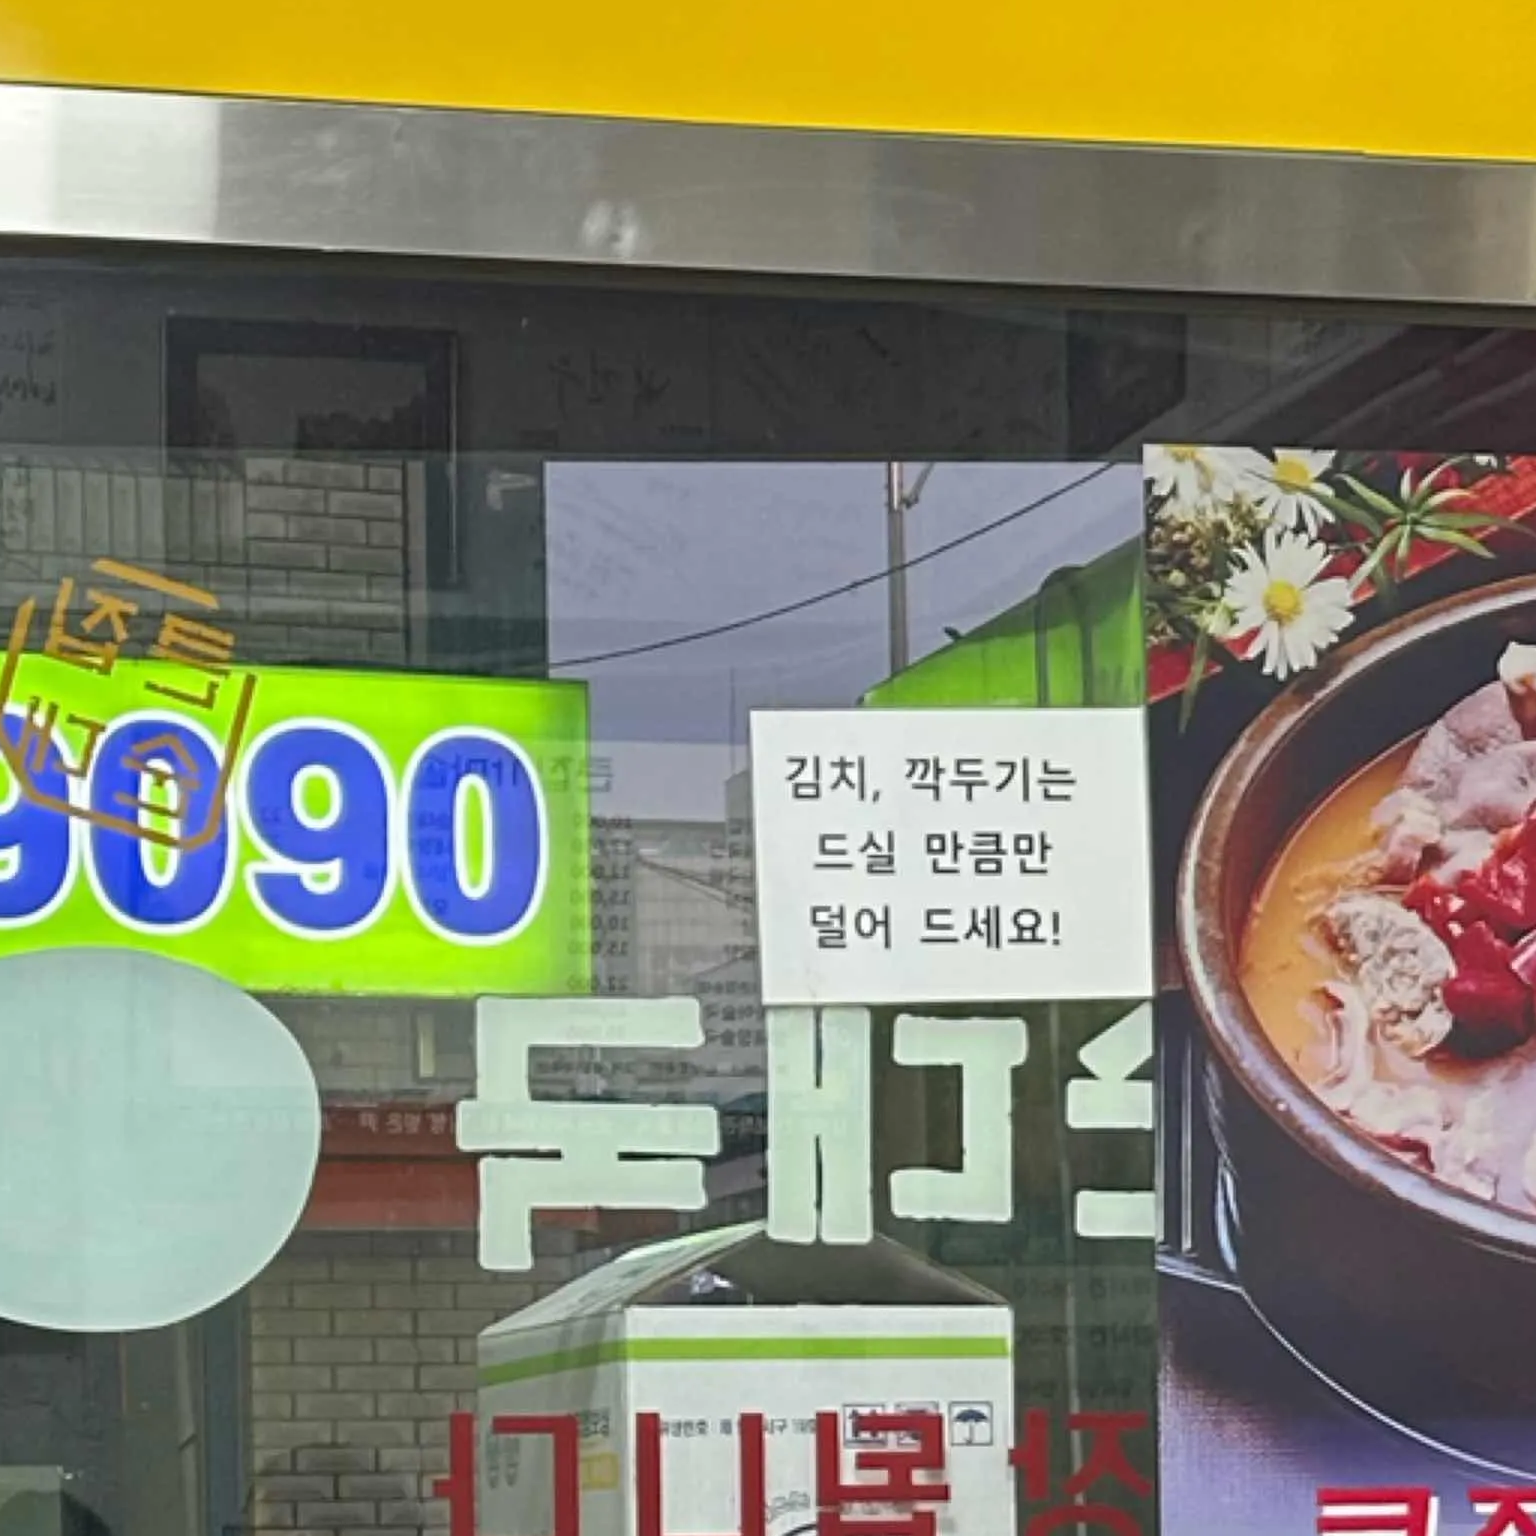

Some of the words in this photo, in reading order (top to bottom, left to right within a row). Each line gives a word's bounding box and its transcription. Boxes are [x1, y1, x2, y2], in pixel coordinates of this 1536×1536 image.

[785, 755, 883, 804] 김치,
[904, 755, 1077, 803] 깍두기는
[813, 830, 897, 875] 드실
[925, 830, 1053, 875] 만큼만
[810, 903, 892, 950] 덜어
[920, 904, 1062, 950] 드세요!
